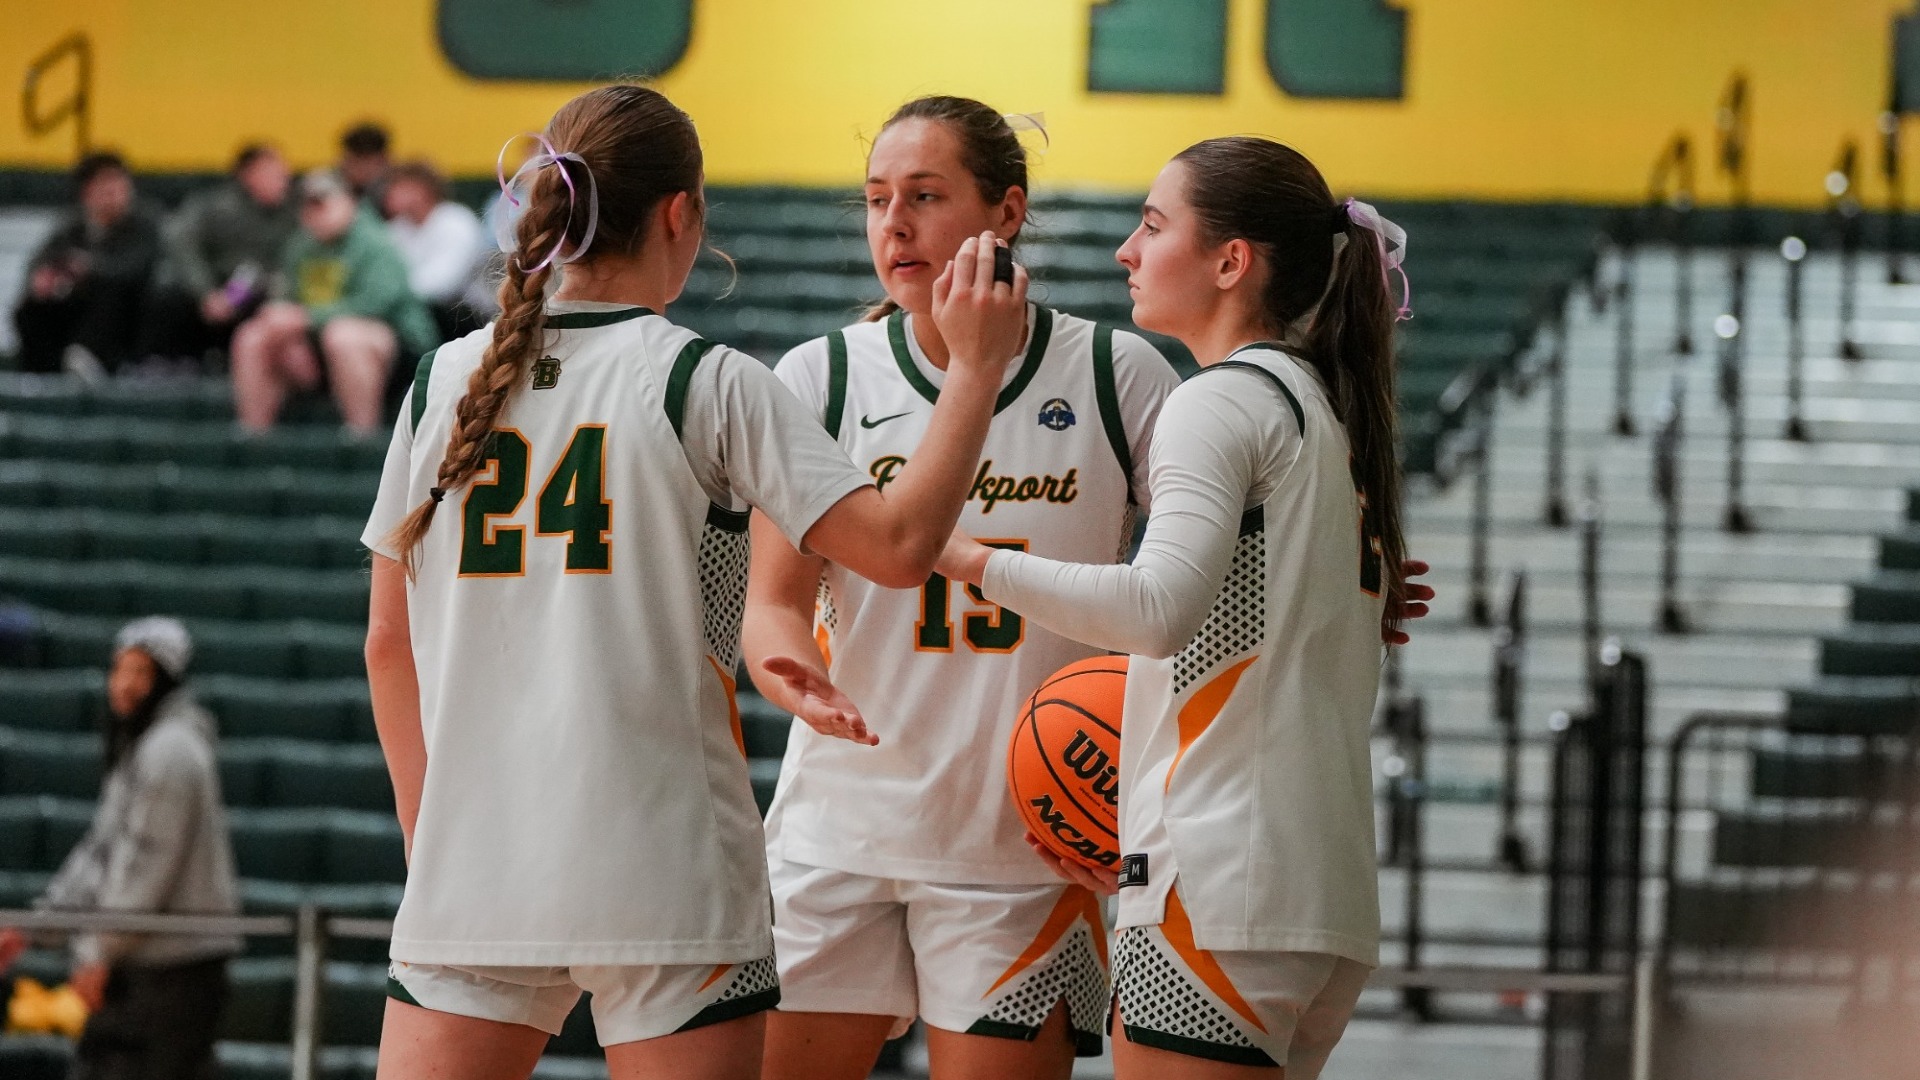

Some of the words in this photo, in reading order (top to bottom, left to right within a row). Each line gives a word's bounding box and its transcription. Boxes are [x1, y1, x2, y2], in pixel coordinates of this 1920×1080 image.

[531, 355, 562, 390] B
[458, 423, 613, 578] 24
[914, 538, 1029, 654] 15
[1031, 794, 1120, 867] NCAA
[1131, 863, 1140, 877] M
